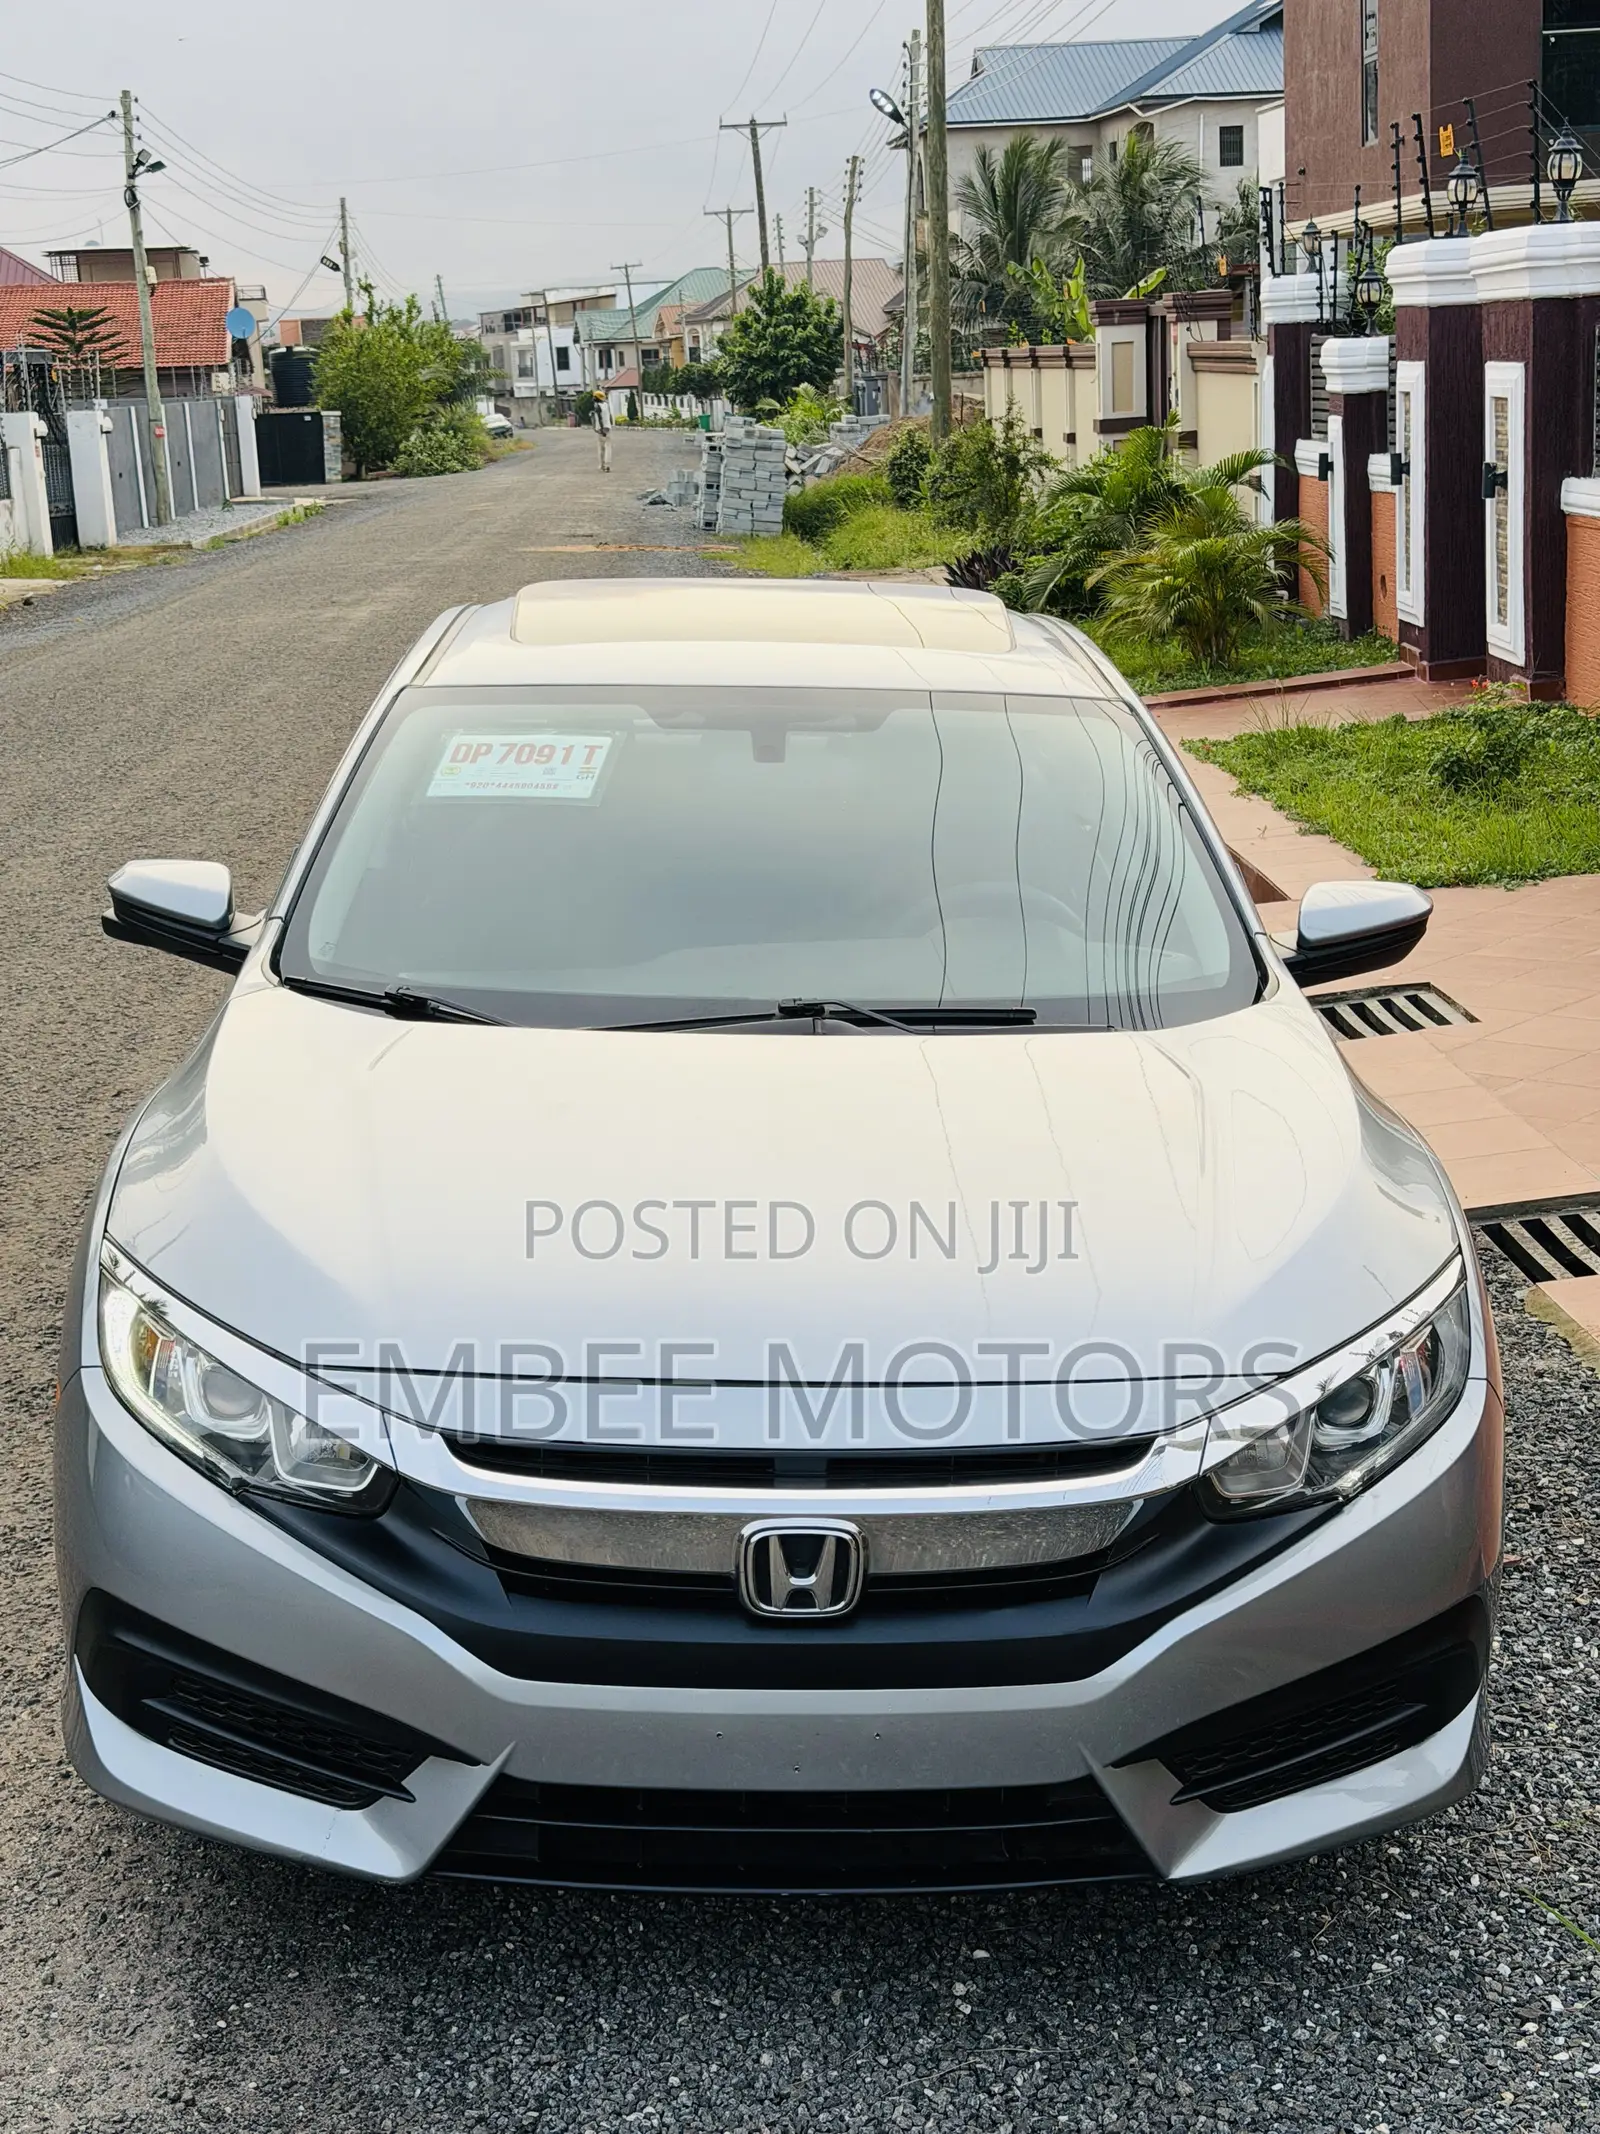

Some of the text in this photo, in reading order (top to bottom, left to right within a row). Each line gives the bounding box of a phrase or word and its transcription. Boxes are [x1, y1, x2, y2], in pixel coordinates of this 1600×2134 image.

[449, 743, 603, 765] DP 7091 T
